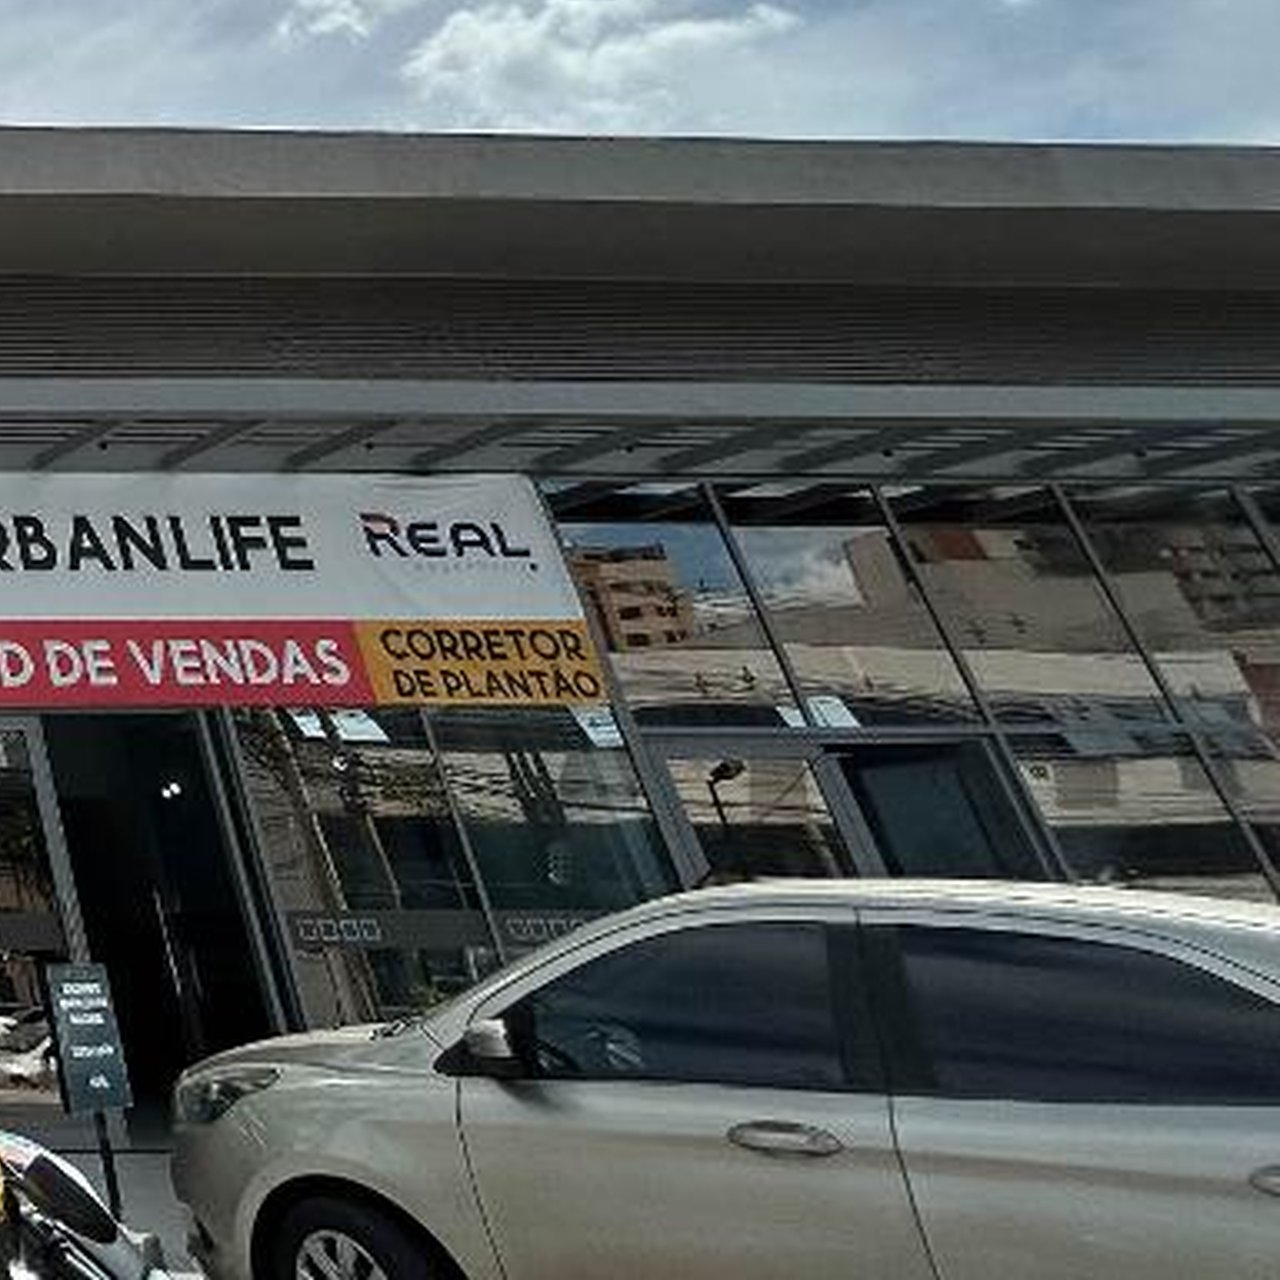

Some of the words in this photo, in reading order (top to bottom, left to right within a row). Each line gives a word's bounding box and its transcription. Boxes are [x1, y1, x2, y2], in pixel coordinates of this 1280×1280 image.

[359, 513, 532, 557] REAL
[43, 639, 119, 688] DE
[127, 637, 351, 687] VENDAS
[380, 628, 588, 662] CORRETOR
[392, 670, 437, 698] DE
[439, 663, 601, 699] PLANTÃO
